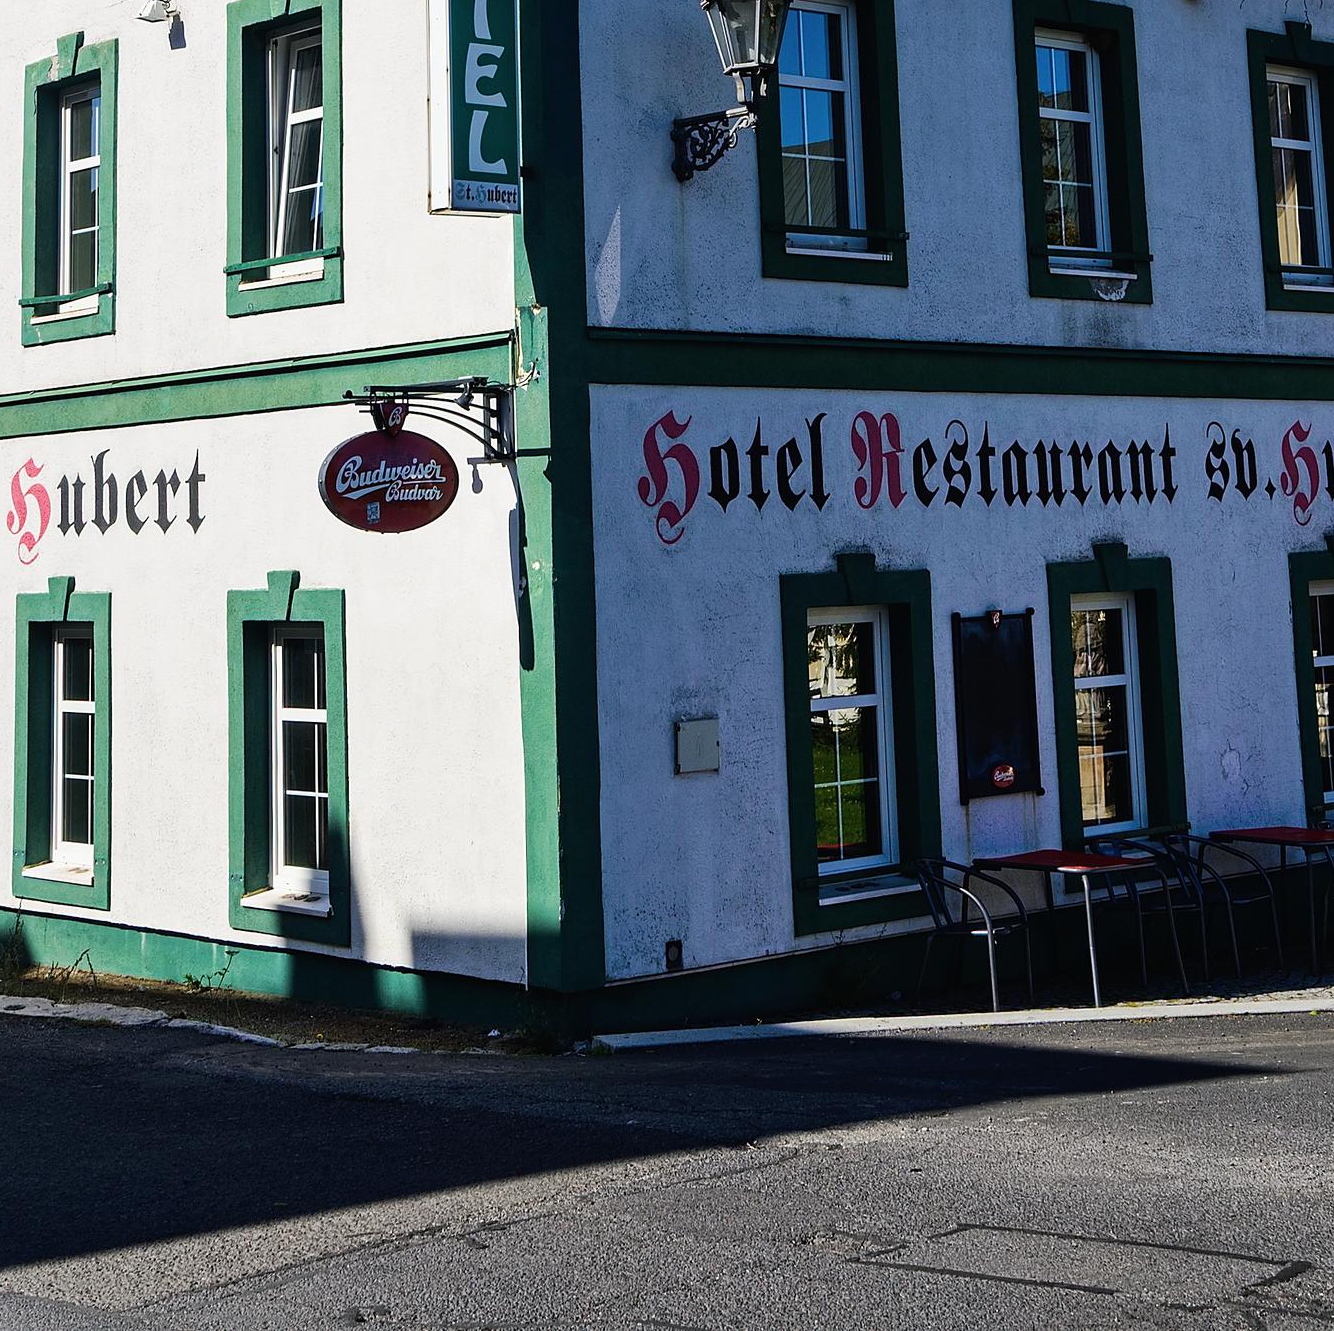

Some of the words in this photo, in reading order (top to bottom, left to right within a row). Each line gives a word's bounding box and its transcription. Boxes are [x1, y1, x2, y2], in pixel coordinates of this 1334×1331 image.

[455, 181, 475, 200] St.
[476, 184, 517, 206] Hubert
[336, 455, 446, 494] Budweiser
[385, 480, 444, 503] Budvar
[638, 410, 831, 545] Hotel
[850, 411, 1179, 510] Restaurant
[6, 448, 206, 566] Hubert
